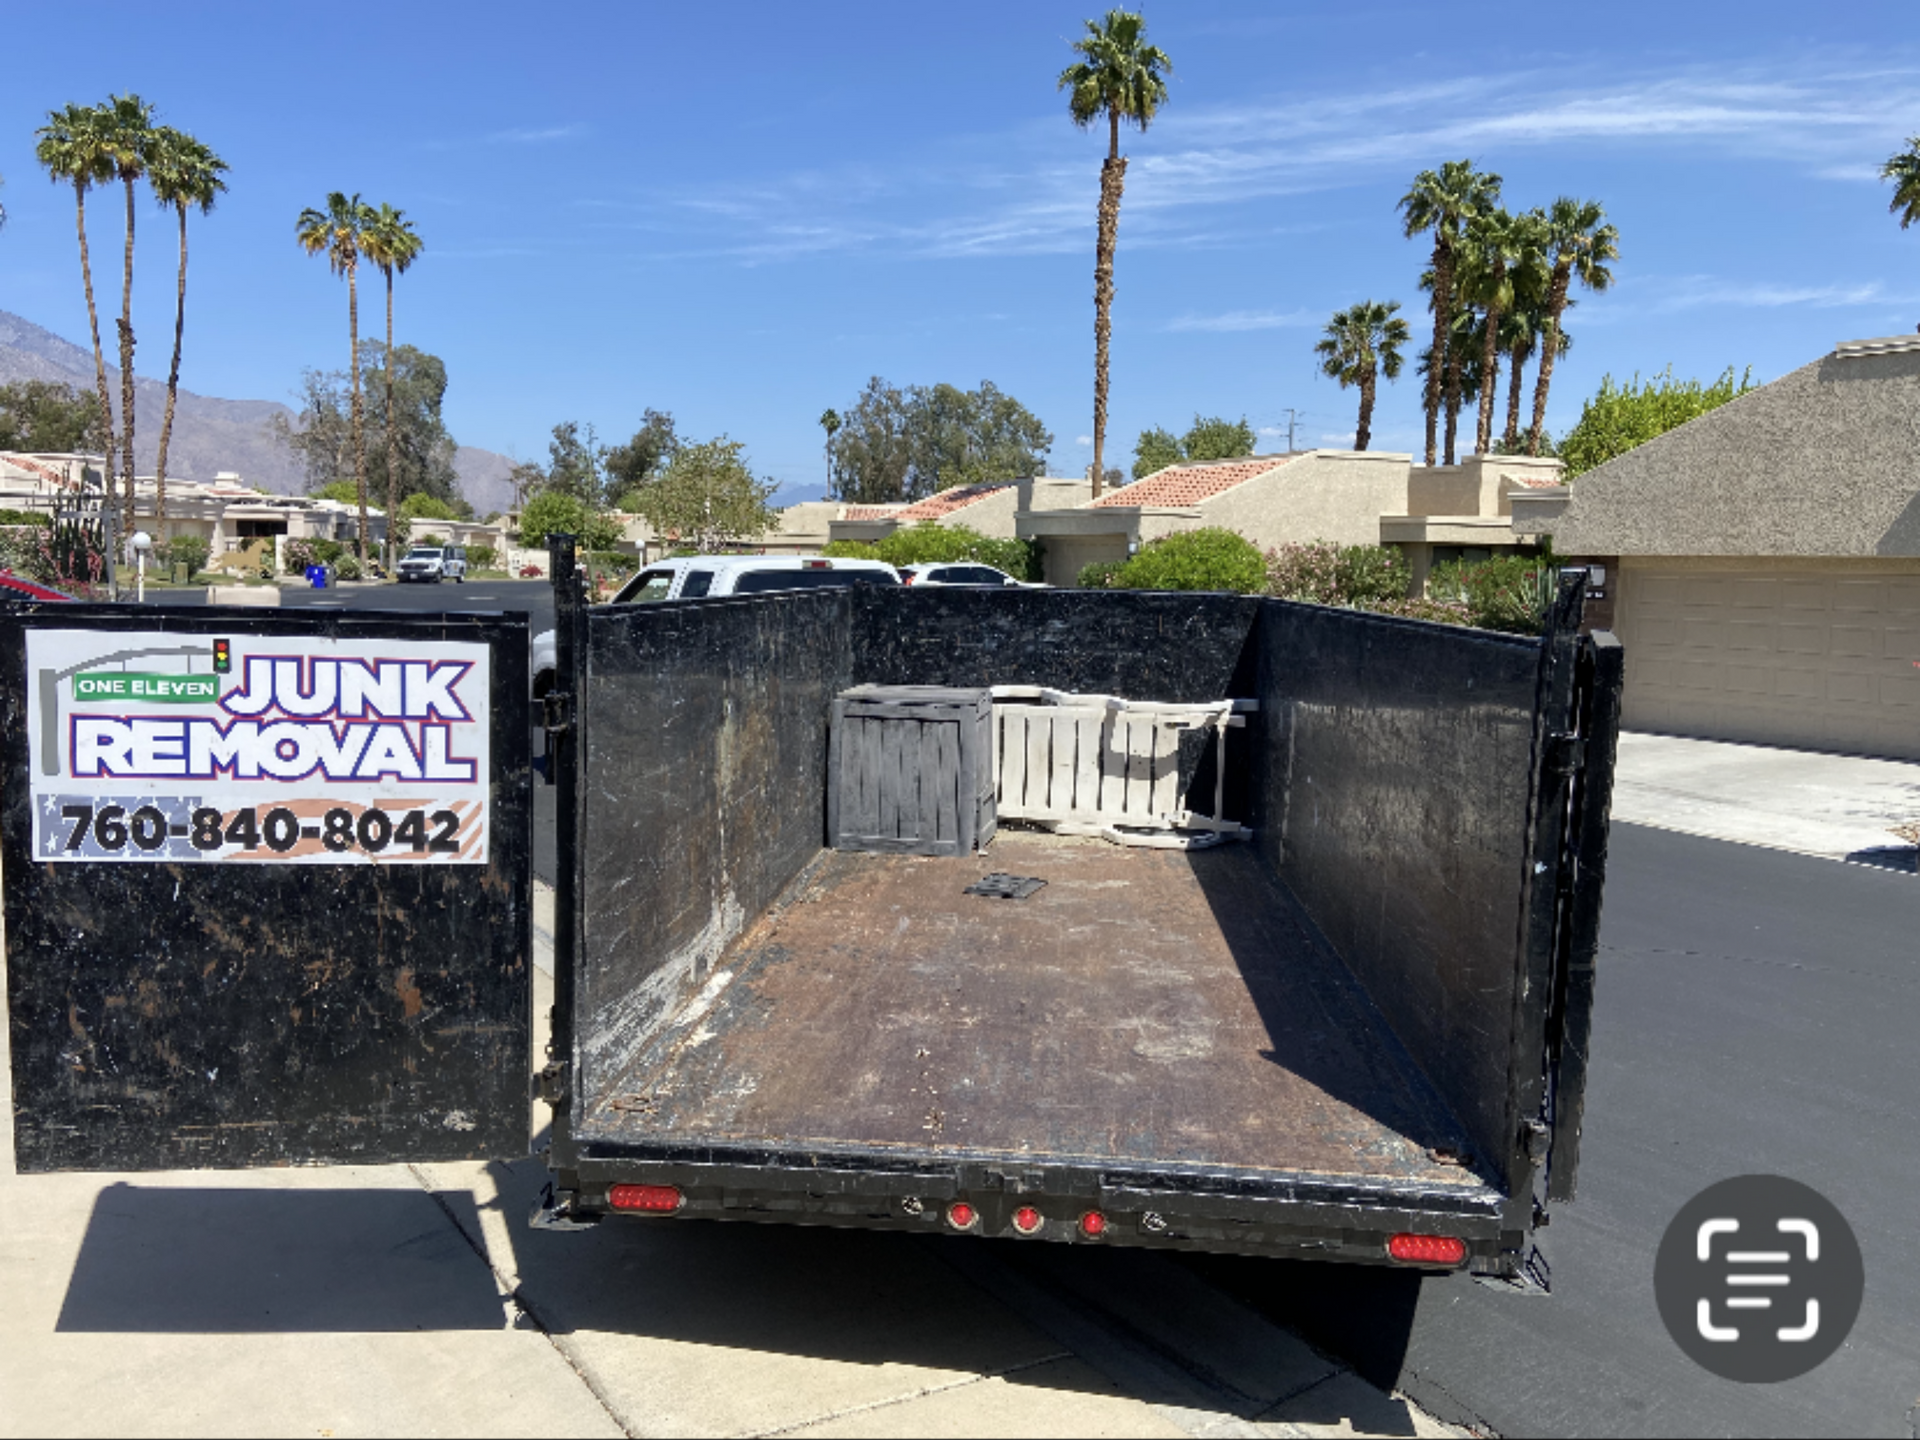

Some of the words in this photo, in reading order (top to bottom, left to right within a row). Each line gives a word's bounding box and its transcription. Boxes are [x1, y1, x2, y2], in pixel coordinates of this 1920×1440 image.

[78, 679, 126, 694] ONE
[132, 681, 215, 696] ELEVEN
[219, 655, 475, 721] JUNK
[70, 714, 478, 782] REMOVAL
[61, 804, 460, 853] 760-840-8042
